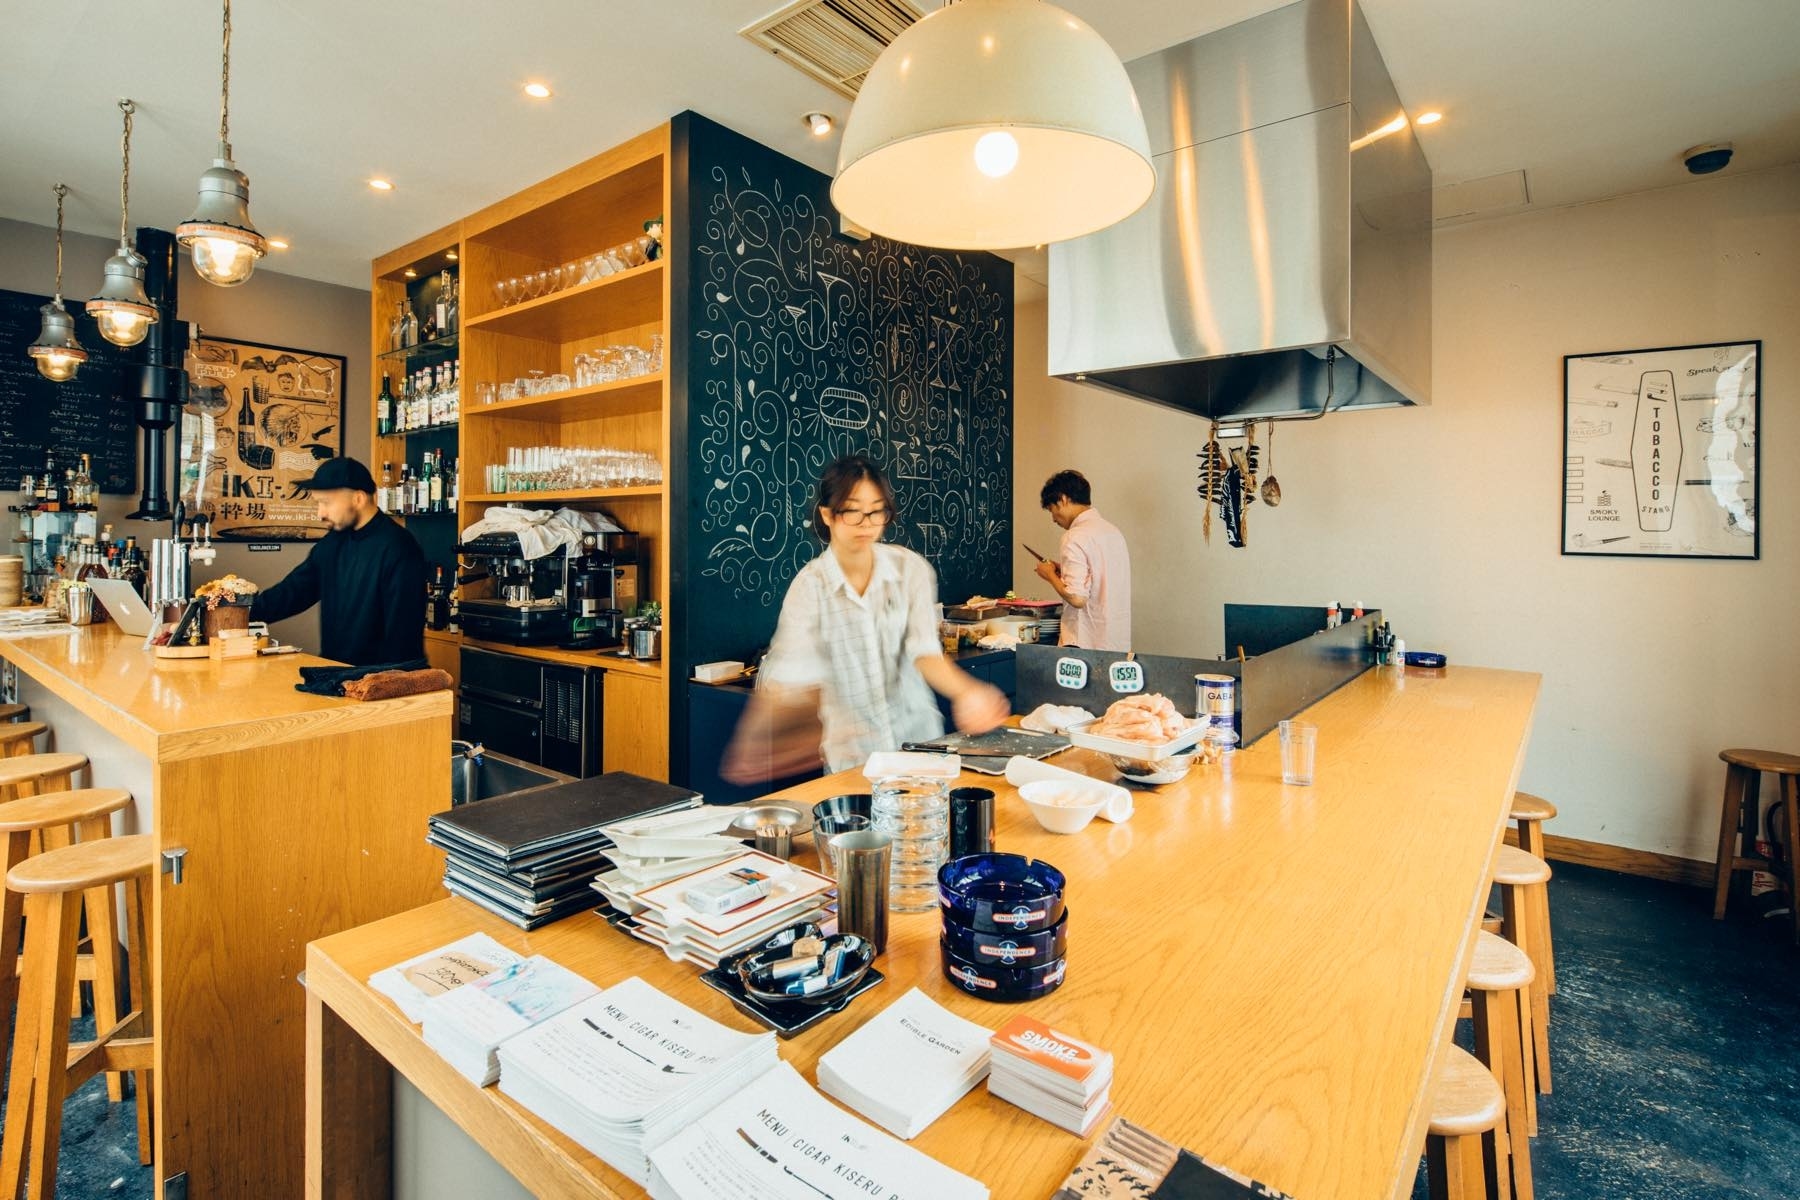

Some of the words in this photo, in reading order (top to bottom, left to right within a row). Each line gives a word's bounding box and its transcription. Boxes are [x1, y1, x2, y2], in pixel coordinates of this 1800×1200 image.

[1652, 407, 1661, 501] TOBACCO
[1641, 505, 1671, 514] STAND
[604, 1004, 629, 1022] MENU
[629, 1022, 660, 1041] CIGAR
[659, 1039, 696, 1060] KISERU
[900, 1018, 928, 1039] EDIBLE
[928, 1036, 961, 1056] GARDEN
[1020, 1030, 1079, 1059] SMOKE
[756, 1109, 789, 1137] MENU
[793, 1138, 831, 1166] CIGAR
[833, 1163, 884, 1196] KISERU
